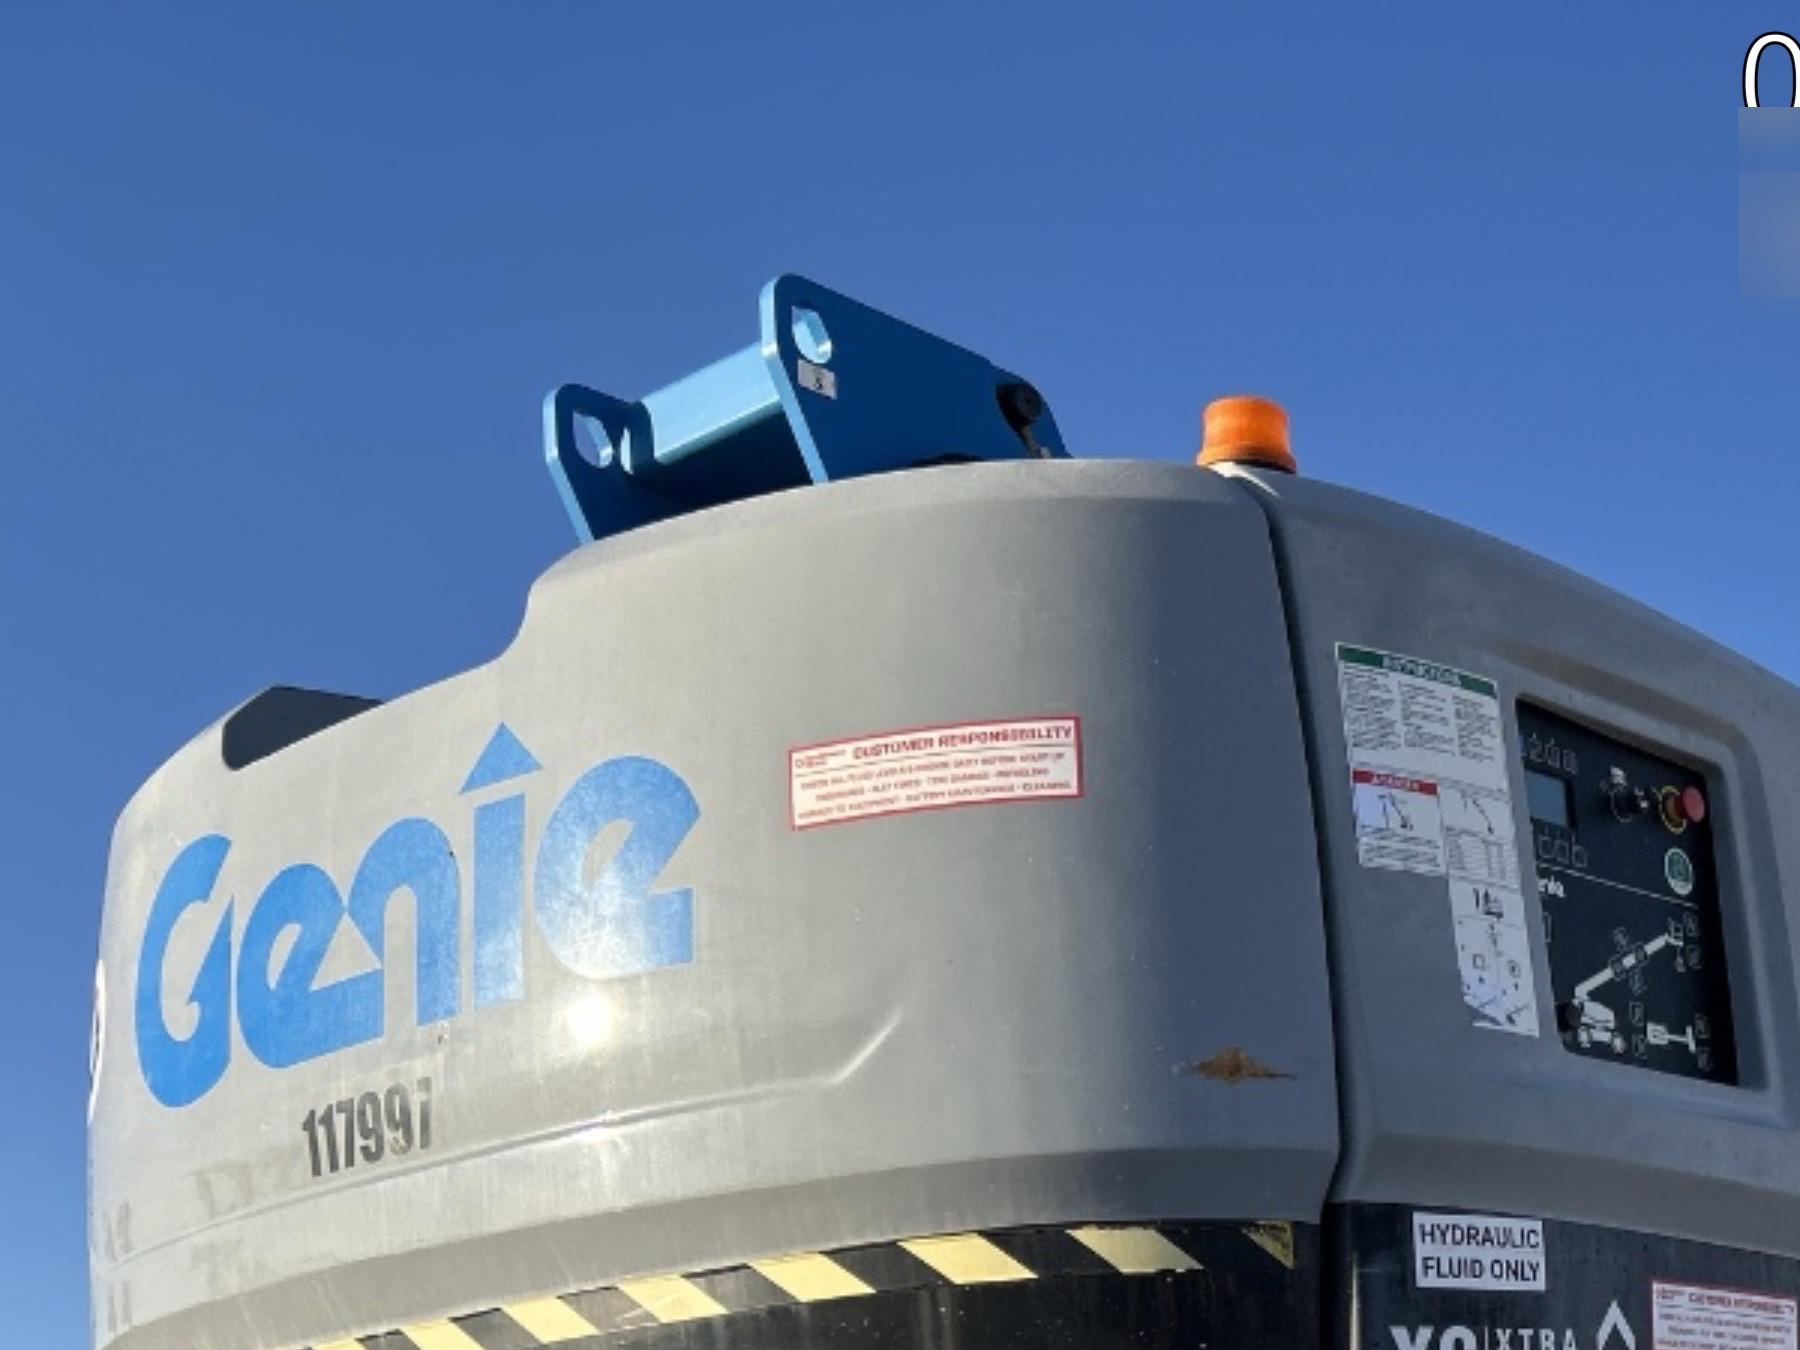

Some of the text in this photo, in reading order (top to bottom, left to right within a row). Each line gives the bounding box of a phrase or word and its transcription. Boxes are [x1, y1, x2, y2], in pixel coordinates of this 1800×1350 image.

[853, 737, 933, 760] CUSTOMER
[135, 722, 701, 1108] Genie
[302, 1076, 433, 1178] 117997
[1418, 1222, 1540, 1249] HYDRAULIC
[1421, 1256, 1540, 1282] FLUID ONLY
